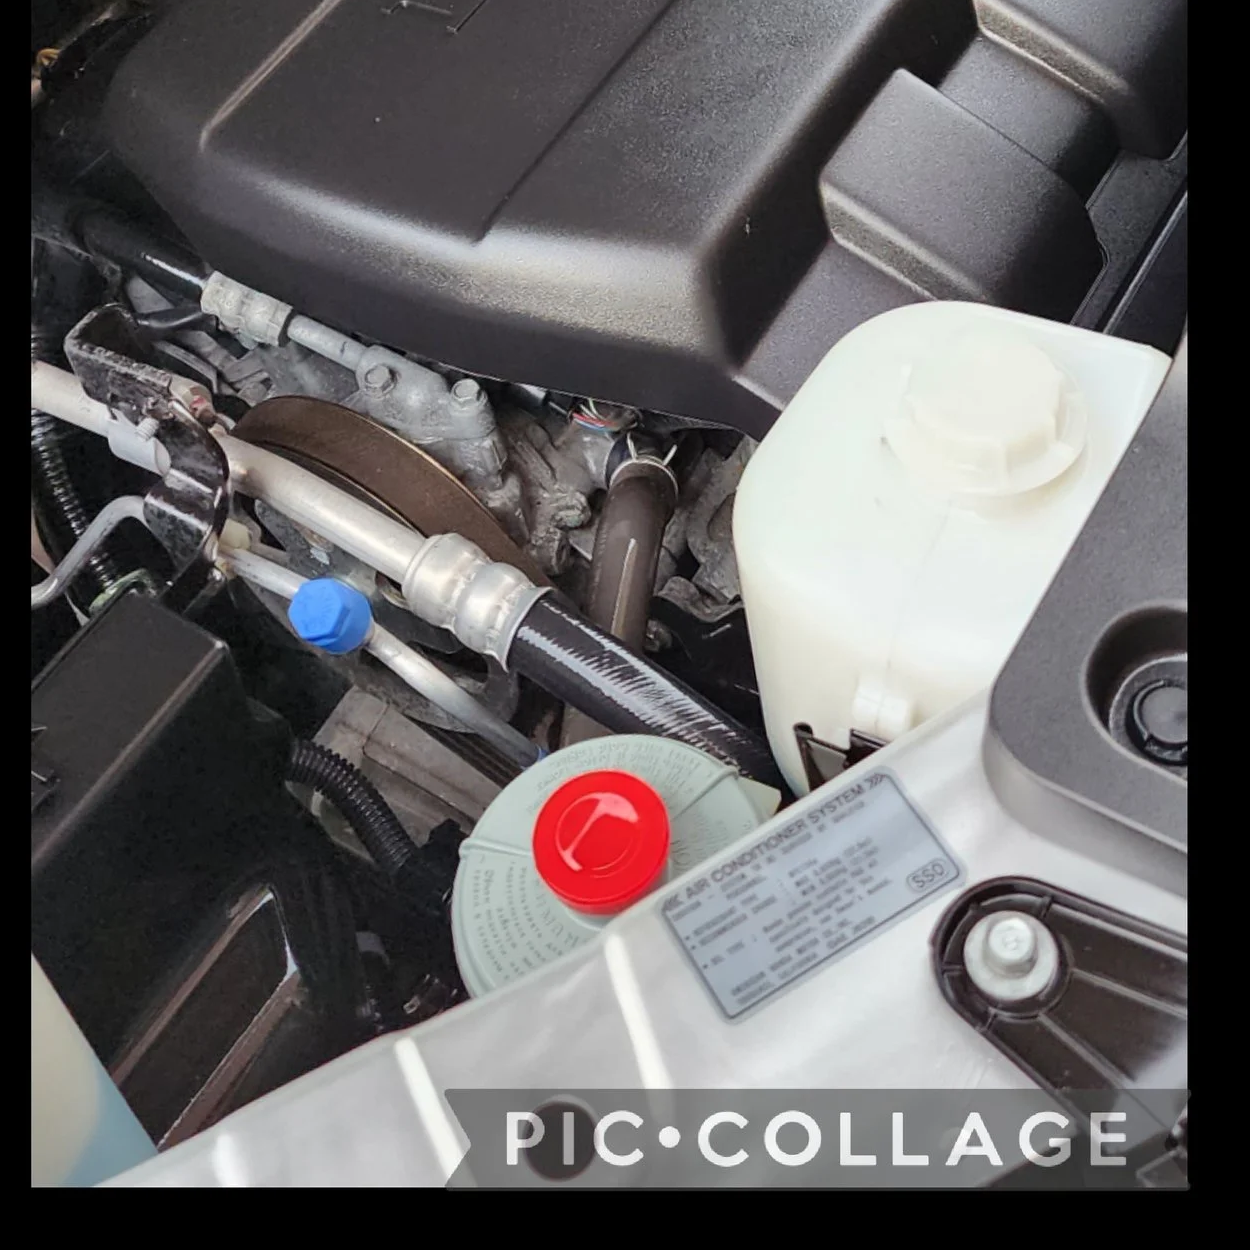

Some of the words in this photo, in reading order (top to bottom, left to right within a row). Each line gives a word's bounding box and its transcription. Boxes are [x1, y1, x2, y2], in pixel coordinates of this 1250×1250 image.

[682, 875, 713, 902] AIR
[708, 813, 809, 887] CONDITIONER
[805, 779, 866, 826] SYSTEM
